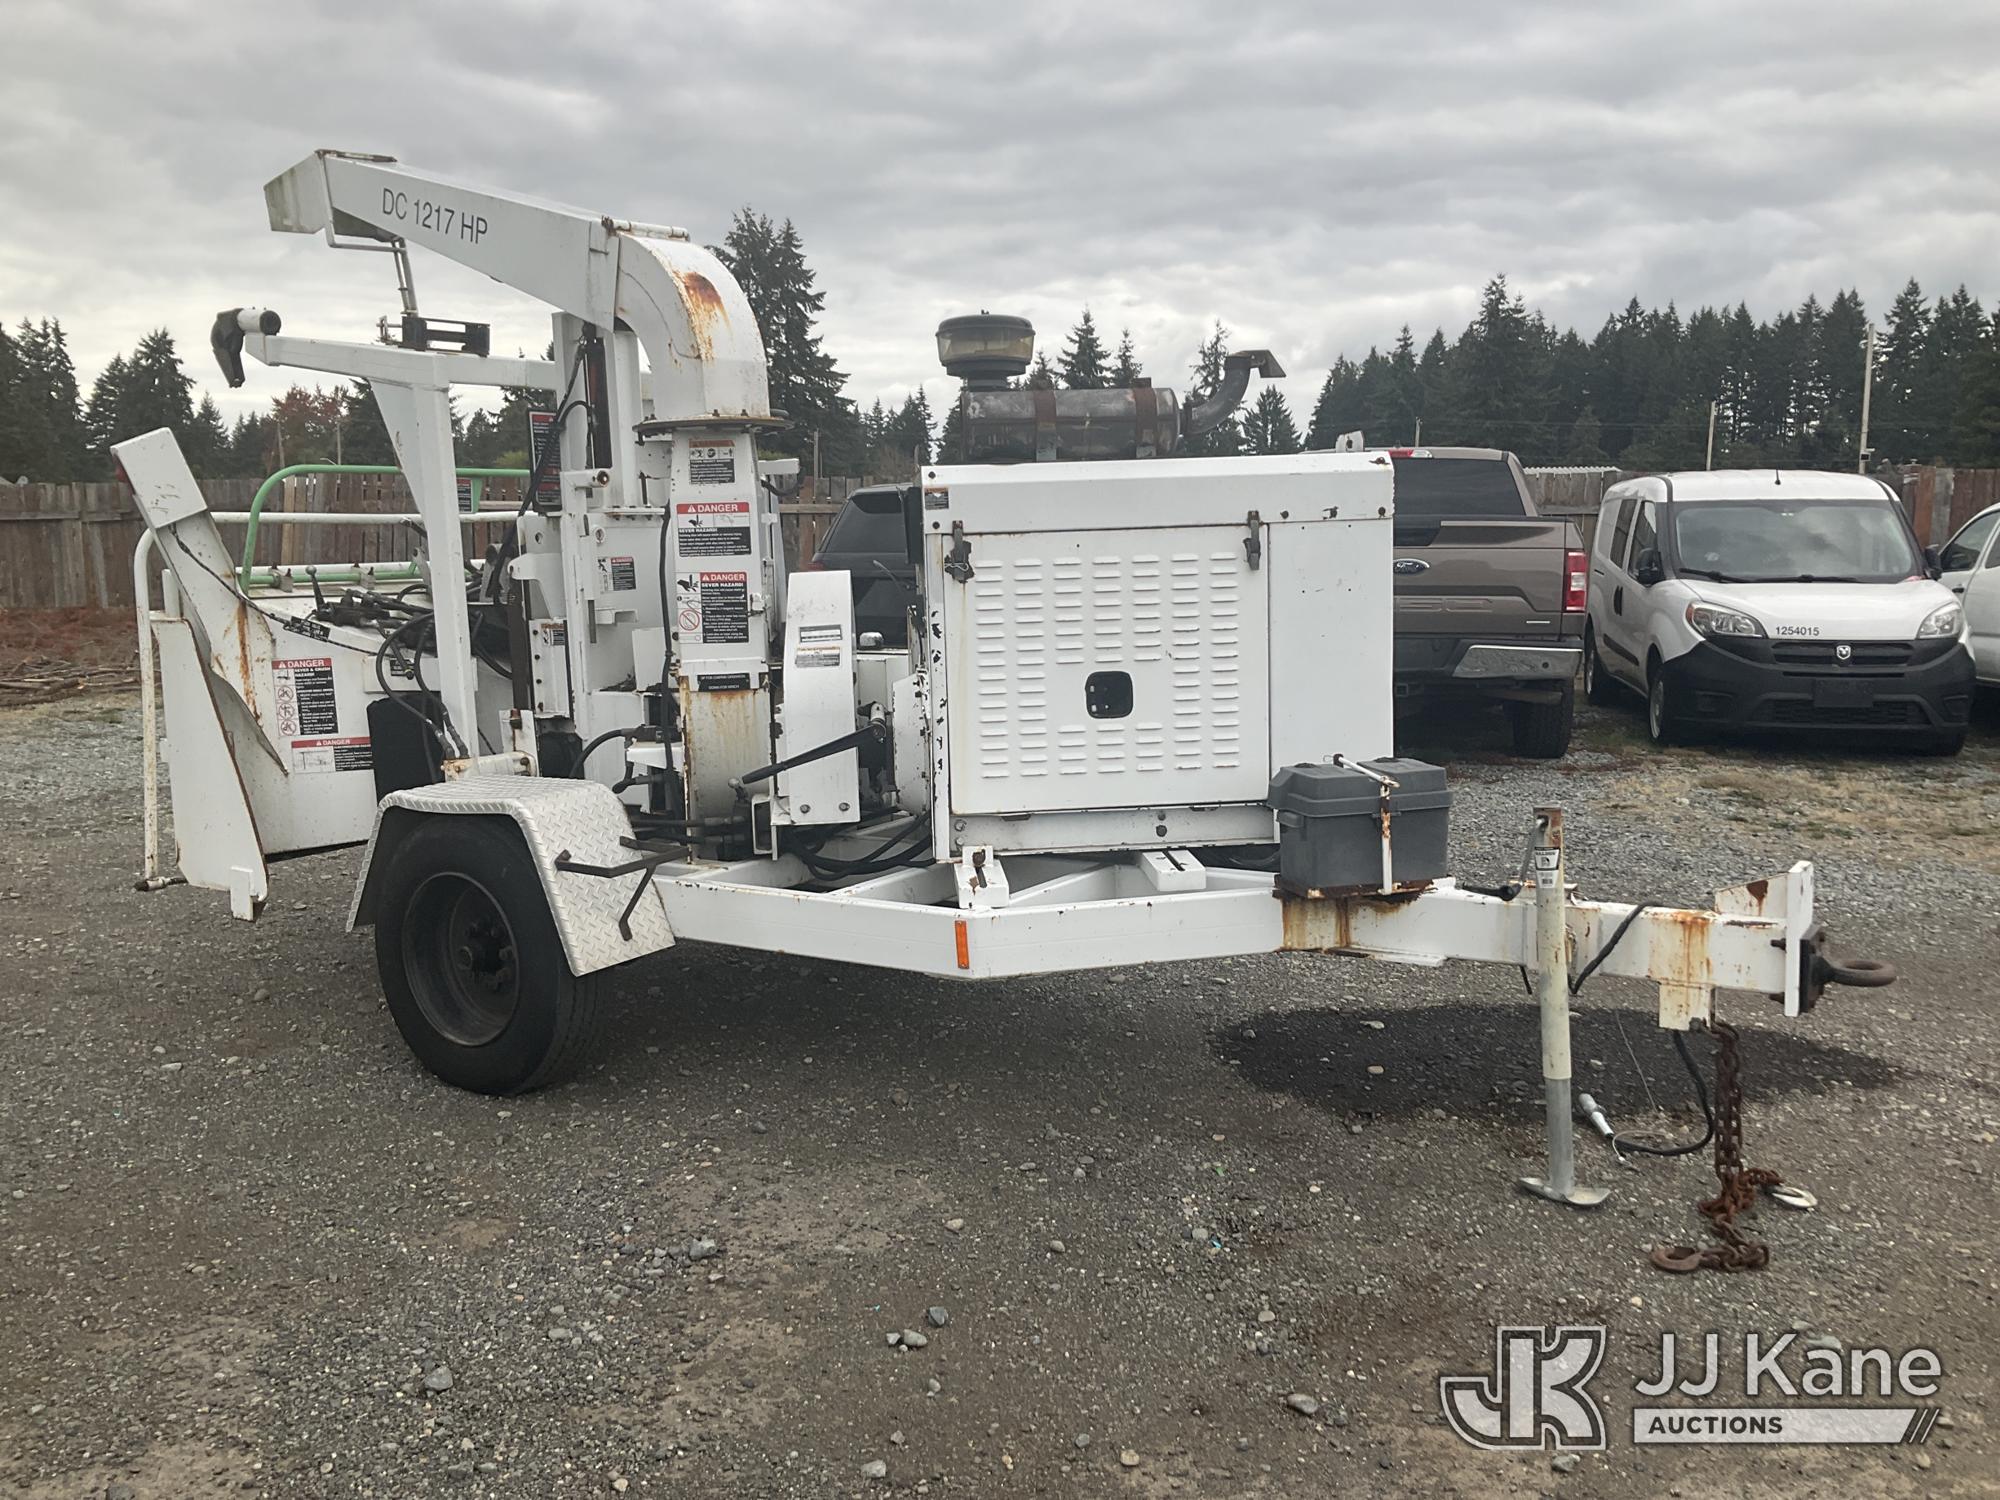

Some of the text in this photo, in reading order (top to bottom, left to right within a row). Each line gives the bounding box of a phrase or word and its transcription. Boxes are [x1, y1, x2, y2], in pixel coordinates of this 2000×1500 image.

[382, 188, 488, 244] DC 1217 HP
[697, 504, 738, 512] DANGER
[1775, 626, 1820, 636] 1254015
[287, 659, 325, 668] DANGER
